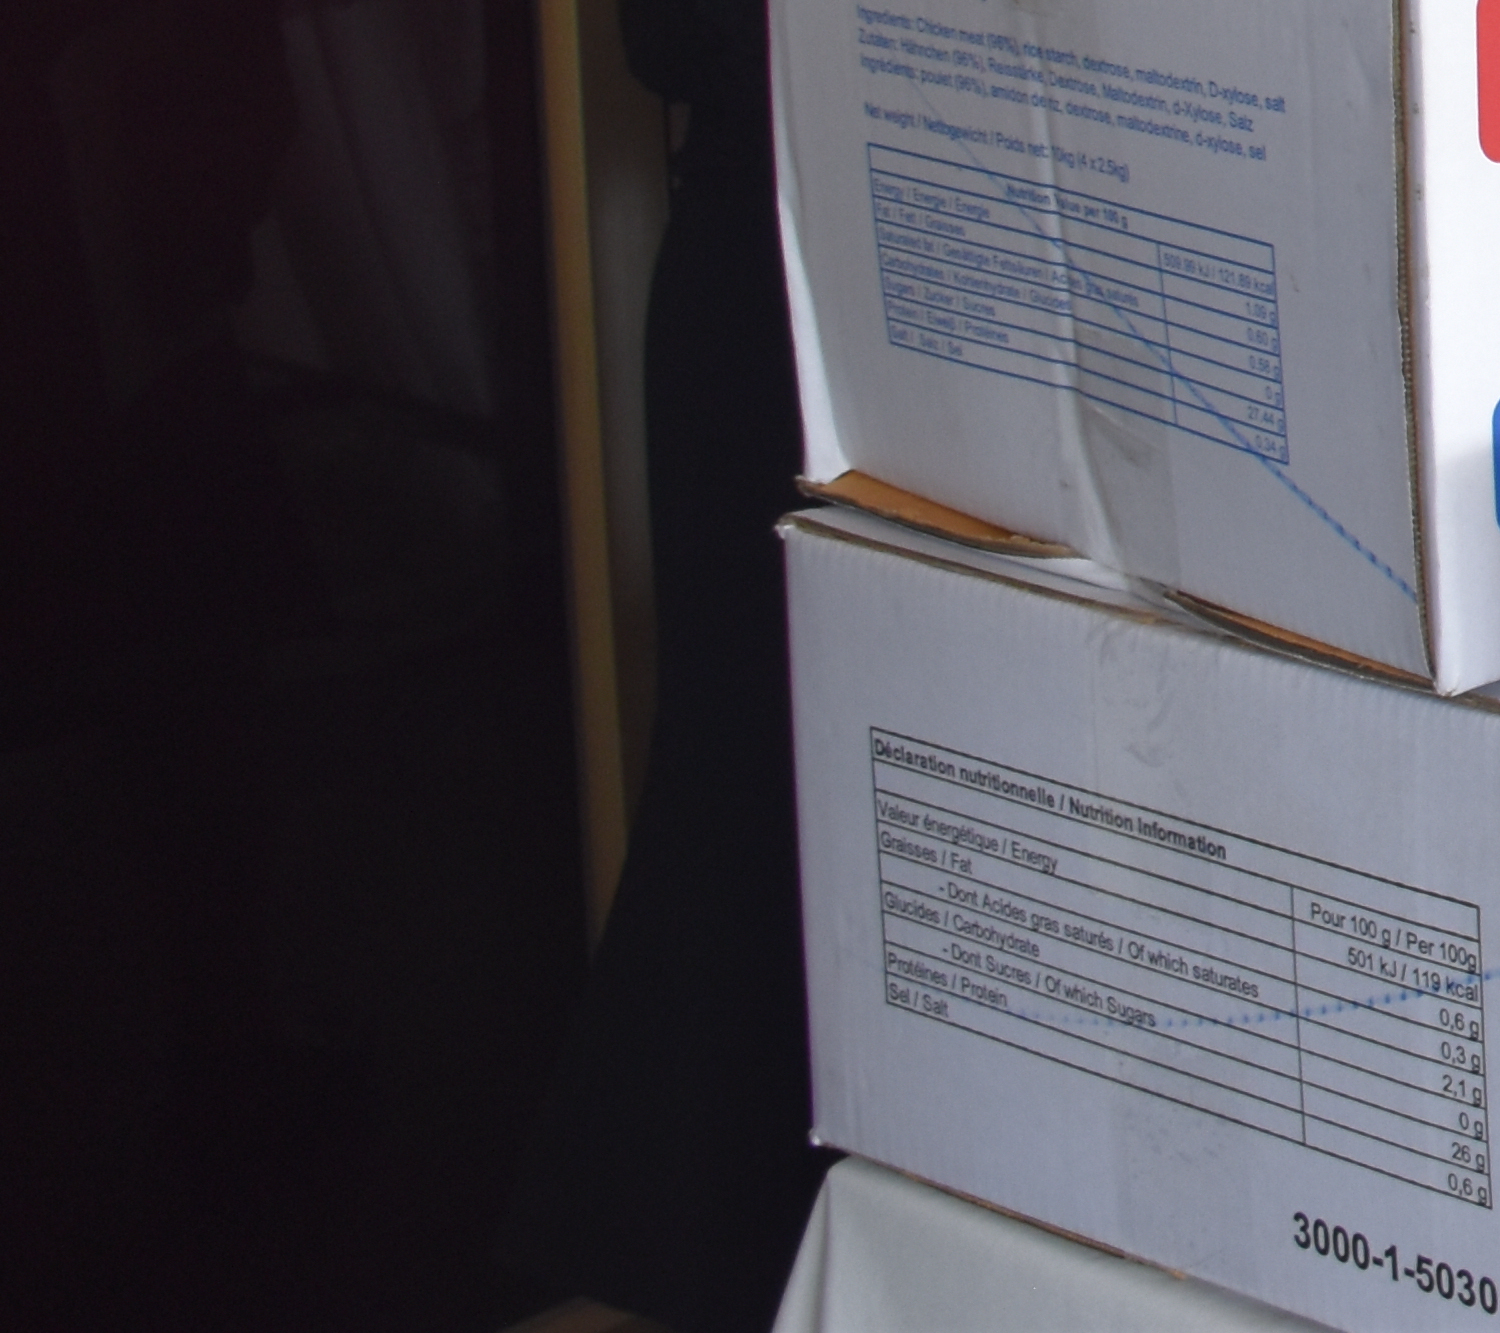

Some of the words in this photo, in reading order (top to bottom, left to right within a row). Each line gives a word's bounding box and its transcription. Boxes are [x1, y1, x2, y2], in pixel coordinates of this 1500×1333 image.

[958, 760, 1055, 808] nutritionnelle
[1068, 794, 1133, 833] Nutrition
[1137, 815, 1228, 862] Information
[1309, 901, 1346, 930] Pour
[1350, 912, 1377, 939] 100
[1381, 924, 1391, 947] g
[1405, 927, 1435, 956] Per
[1439, 937, 1478, 972] 100g
[1293, 1211, 1499, 1315] 3000-1-5030
